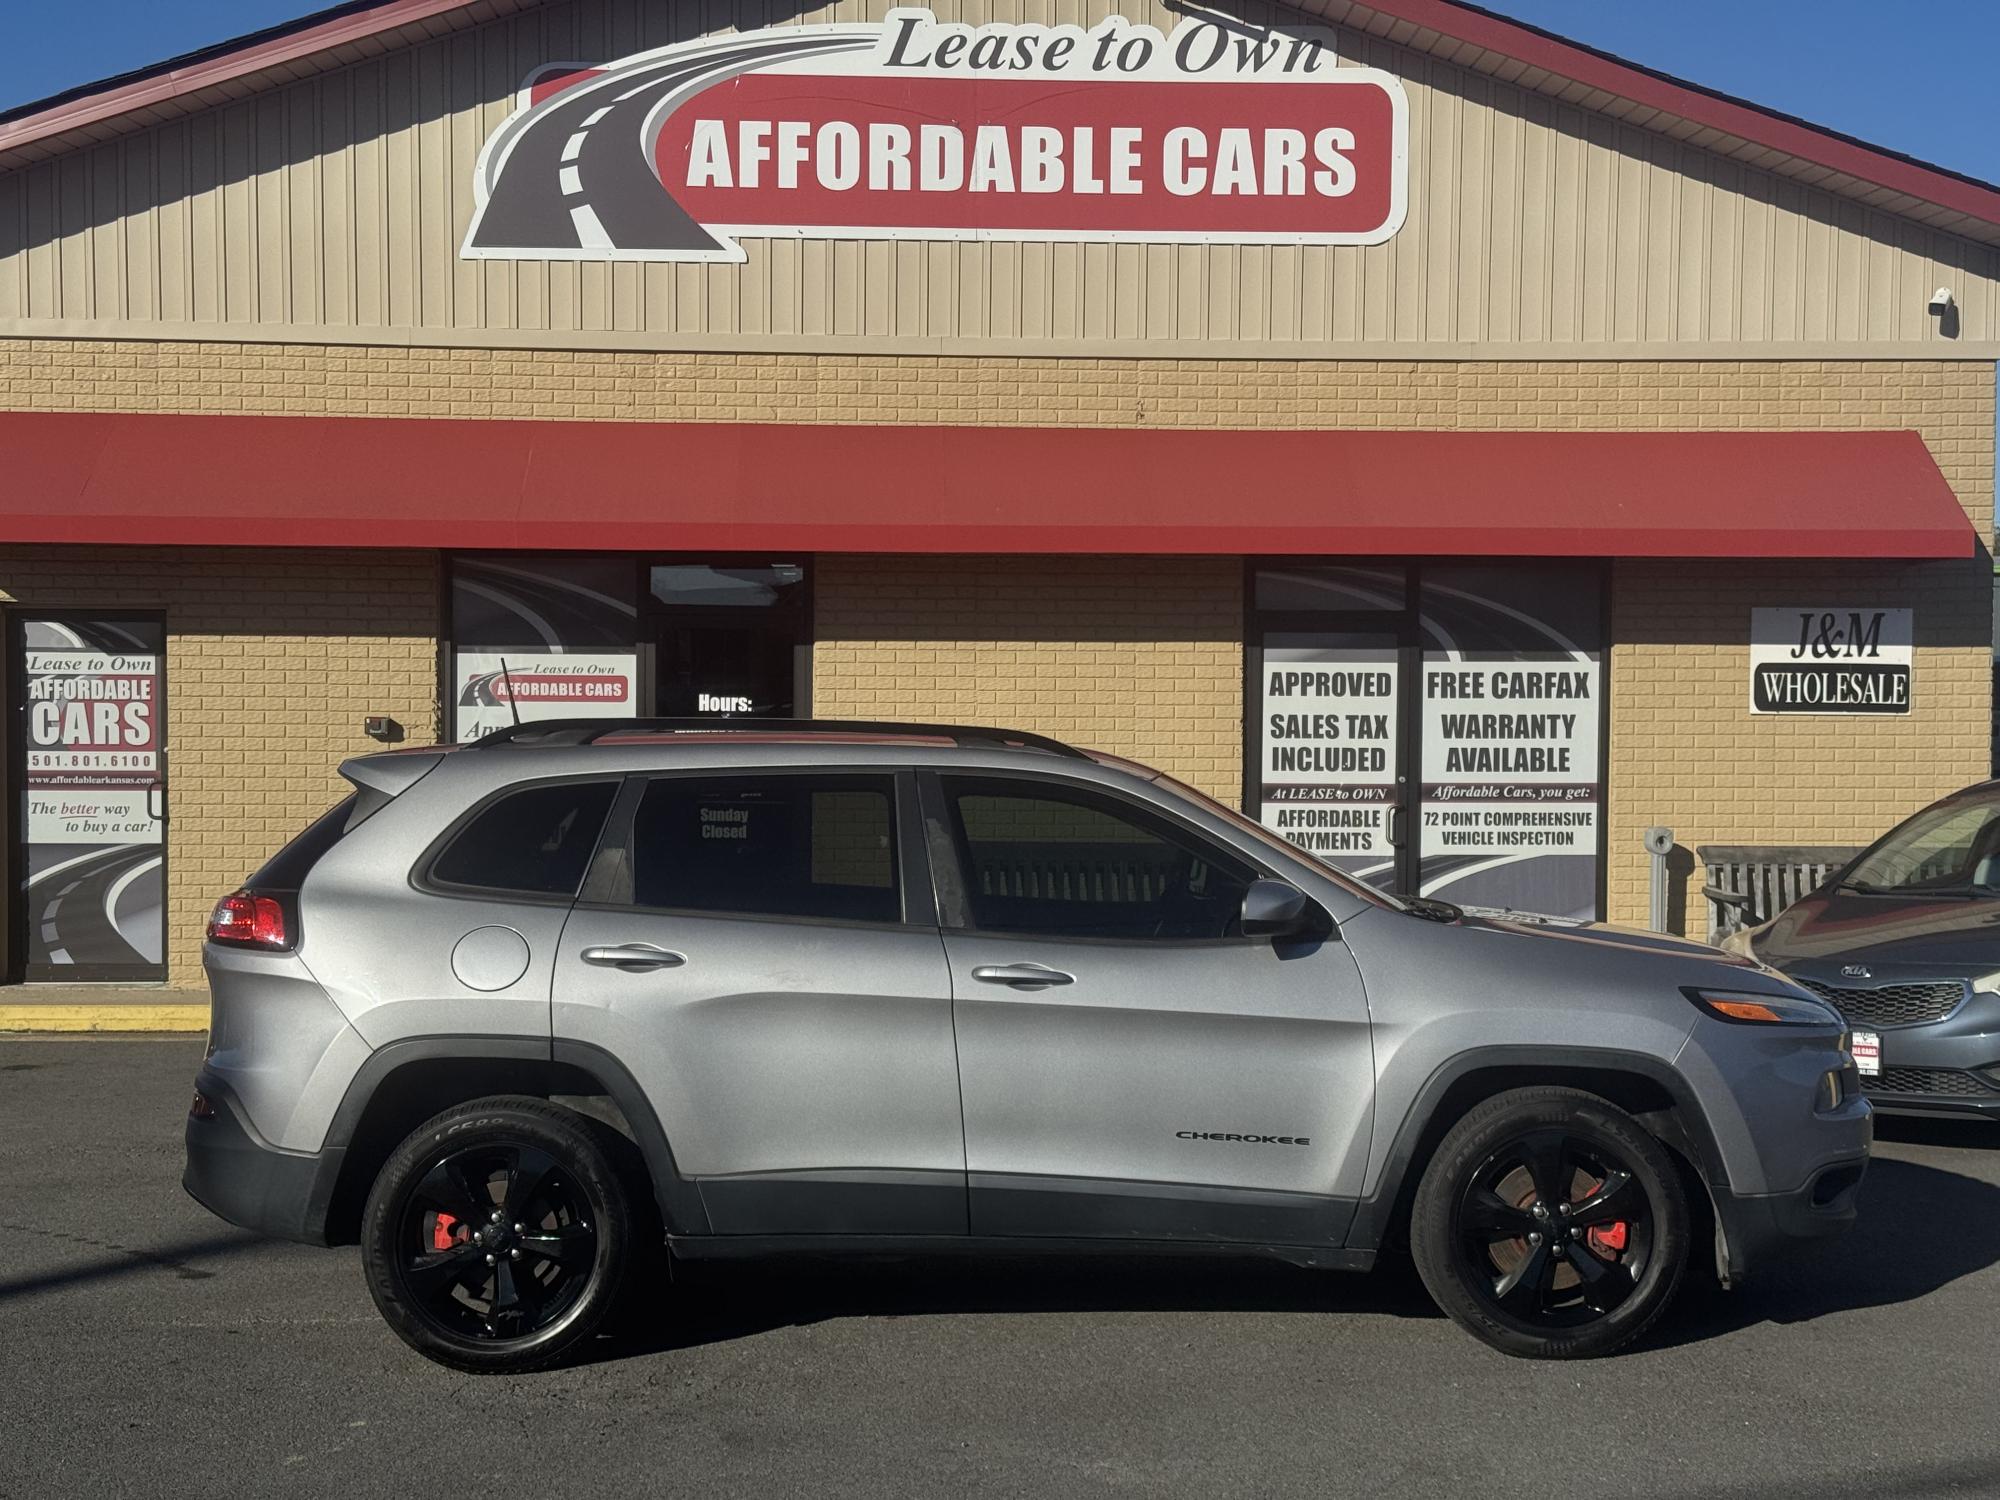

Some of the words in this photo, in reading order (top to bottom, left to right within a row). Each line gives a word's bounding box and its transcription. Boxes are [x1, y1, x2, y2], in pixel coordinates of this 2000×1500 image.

[883, 18, 1075, 72] Lease
[1092, 28, 1153, 73] to
[1174, 23, 1322, 73] Own
[686, 119, 1143, 194] AFFORDABLE
[1163, 126, 1356, 197] CARS
[1790, 612, 1886, 659] J&M
[30, 656, 82, 671] Lease
[87, 659, 104, 671] to
[111, 657, 151, 671] Own
[534, 664, 570, 674] Lease
[572, 664, 583, 674] to
[587, 664, 615, 674] Own
[30, 679, 151, 700] AFFORDABLE
[497, 682, 583, 697] AFFORDABLE
[585, 683, 622, 697] CARS
[1269, 672, 1392, 697] APPROVED
[1427, 672, 1485, 699] FREE
[1491, 672, 1590, 699] CARFAX
[1762, 672, 1906, 705] WHOLESALE
[698, 693, 753, 712] Hours:
[32, 701, 151, 746] CARS
[1270, 714, 1340, 739] SALES
[1345, 714, 1389, 740] TAX
[1441, 714, 1576, 739] WARRANTY
[32, 755, 151, 766] 501.801.6100
[1272, 747, 1386, 772] INCLUDED
[1446, 747, 1571, 772] AVAILABLE
[1272, 789, 1287, 800] At
[1289, 788, 1335, 800] LEASE
[1336, 790, 1349, 800] to
[1352, 788, 1388, 800] OWN
[1432, 786, 1500, 800] Affordable
[1503, 786, 1536, 799] Cars,
[1538, 790, 1563, 800] you
[1565, 788, 1591, 800] get:
[31, 802, 57, 815] The
[60, 802, 101, 816] better
[104, 805, 130, 817] way
[700, 808, 748, 822] Sunday
[1277, 809, 1381, 828] AFFORDABLE
[65, 821, 79, 832] to
[83, 820, 108, 835] buy
[111, 822, 120, 832] a
[124, 820, 154, 832] car!
[1424, 812, 1439, 826] 72
[1442, 812, 1481, 826] POINT
[1484, 812, 1593, 827] COMPREHENSIVE
[702, 824, 747, 839] Closed
[1442, 831, 1494, 845] VEHICLE
[1497, 831, 1574, 845] INSPECTION
[1175, 1131, 1311, 1146] CHEROKEE
